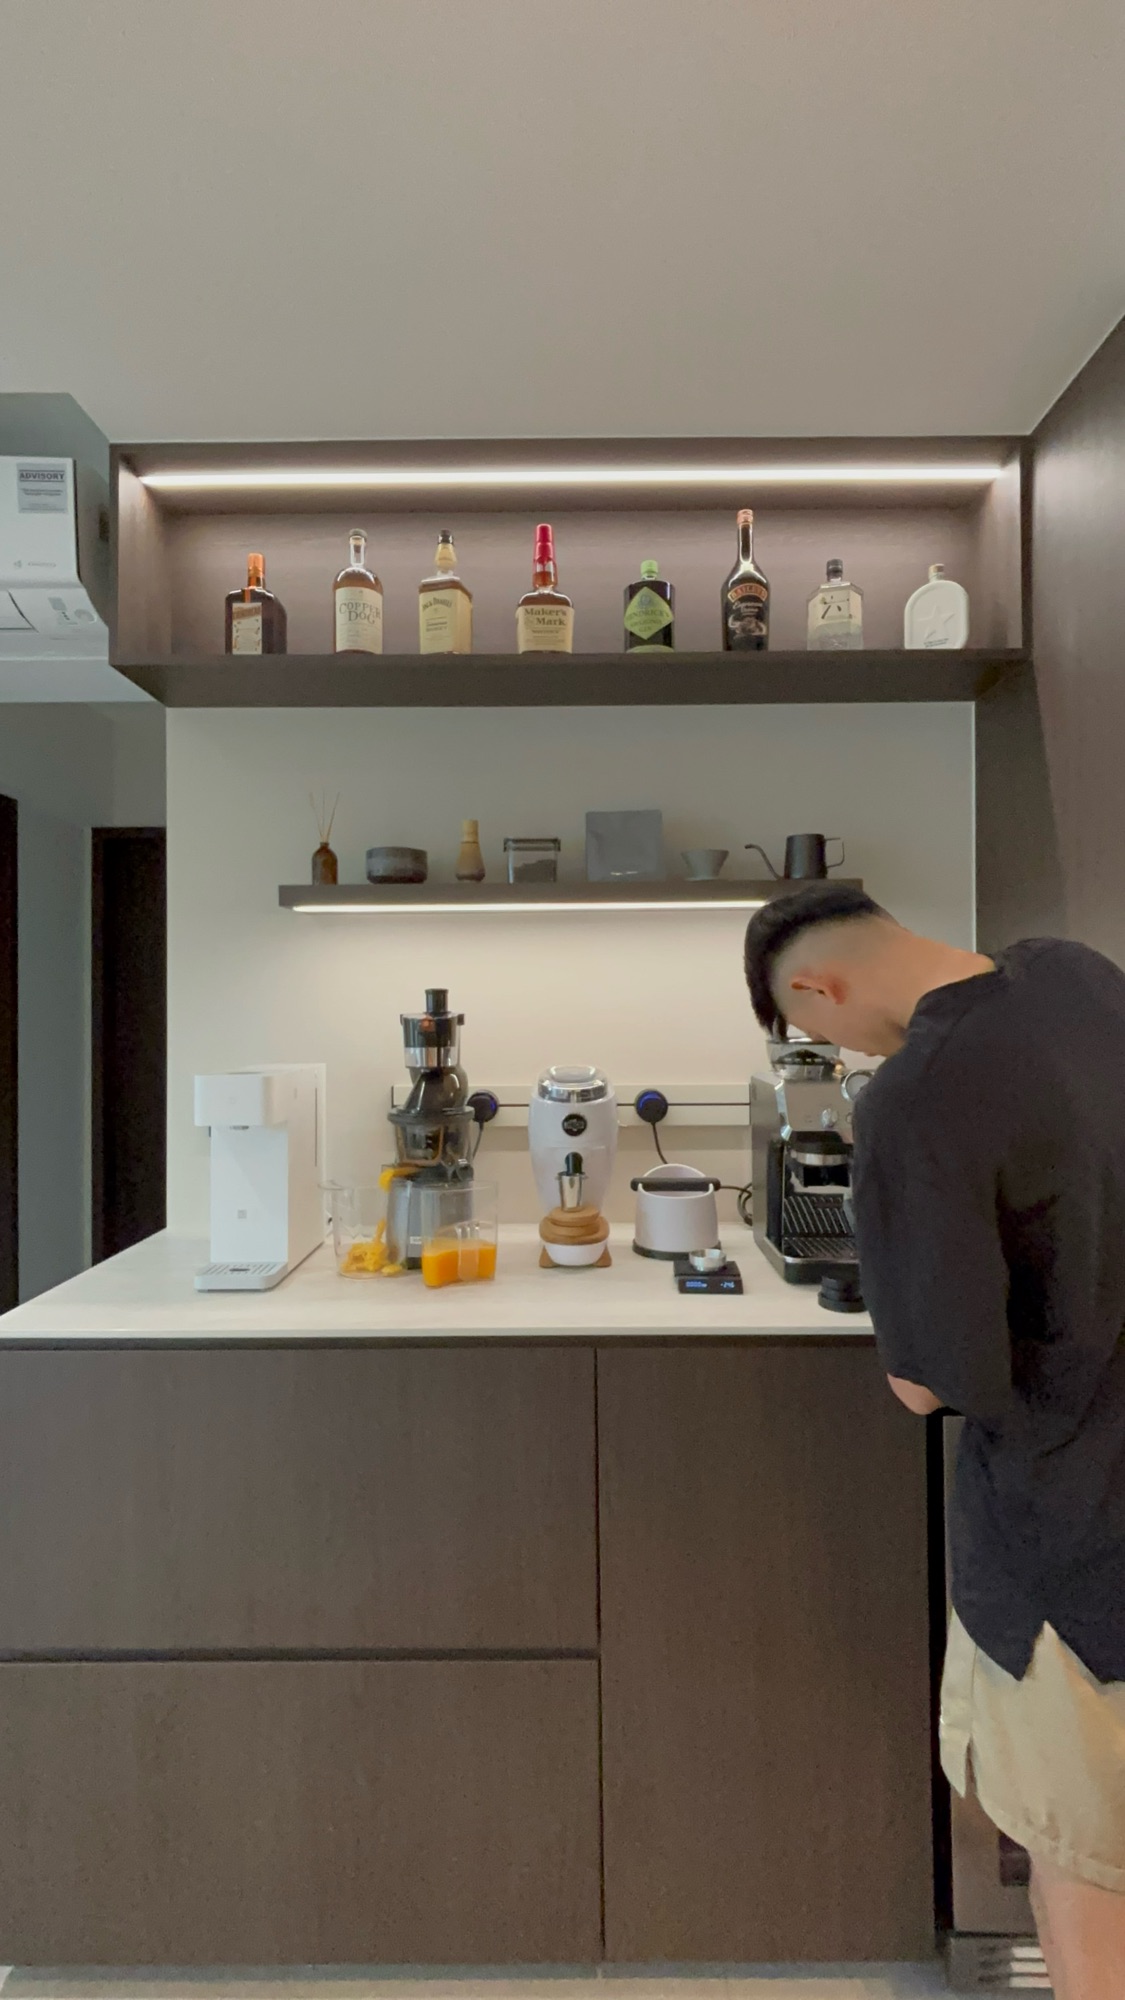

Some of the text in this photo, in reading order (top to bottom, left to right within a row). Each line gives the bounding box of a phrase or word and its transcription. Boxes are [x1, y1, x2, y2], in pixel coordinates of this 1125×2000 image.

[20, 472, 65, 480] ADVISORY
[338, 601, 382, 620] COPPER
[524, 608, 567, 617] Maker's
[348, 610, 375, 625] DOG
[535, 617, 567, 626] Mark
